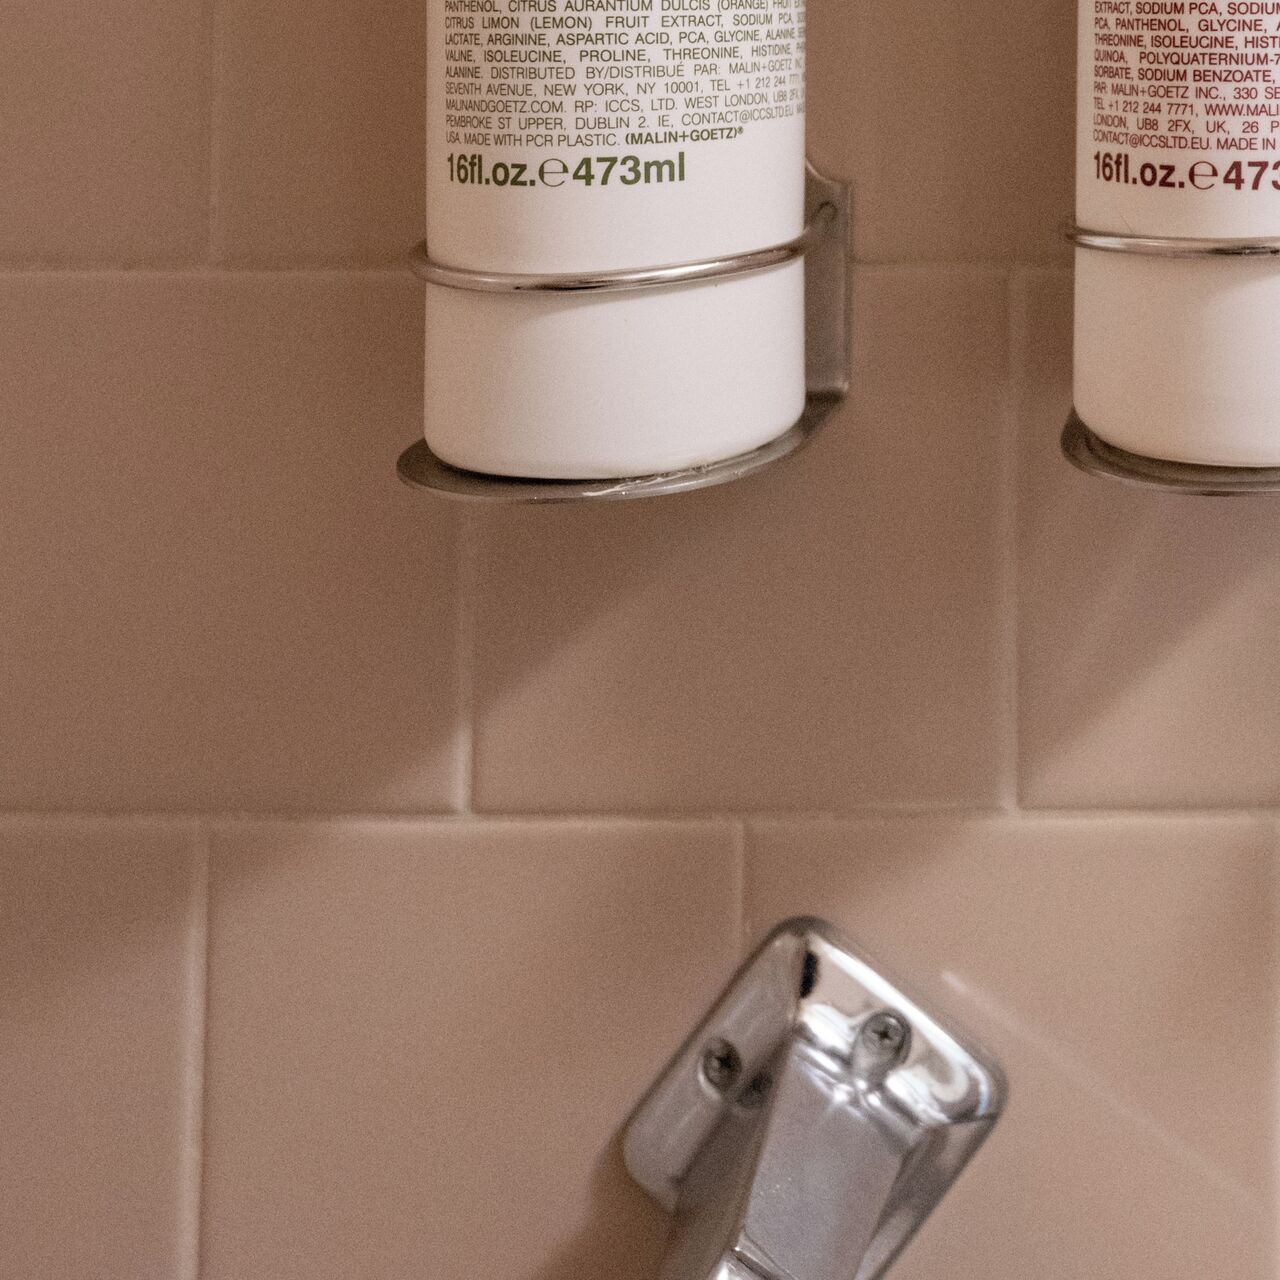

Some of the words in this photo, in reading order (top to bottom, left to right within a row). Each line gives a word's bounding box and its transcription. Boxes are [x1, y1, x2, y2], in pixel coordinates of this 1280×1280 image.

[564, 0, 653, 12] AURANTIUM
[530, 16, 592, 32] (LEMON)
[605, 16, 650, 29] FRUIT
[661, 14, 723, 28] EXTRACT,
[1115, 17, 1189, 33] PANTHENOL,
[1197, 19, 1268, 35] GLYCINE,
[557, 133, 620, 147] PLASTIC.
